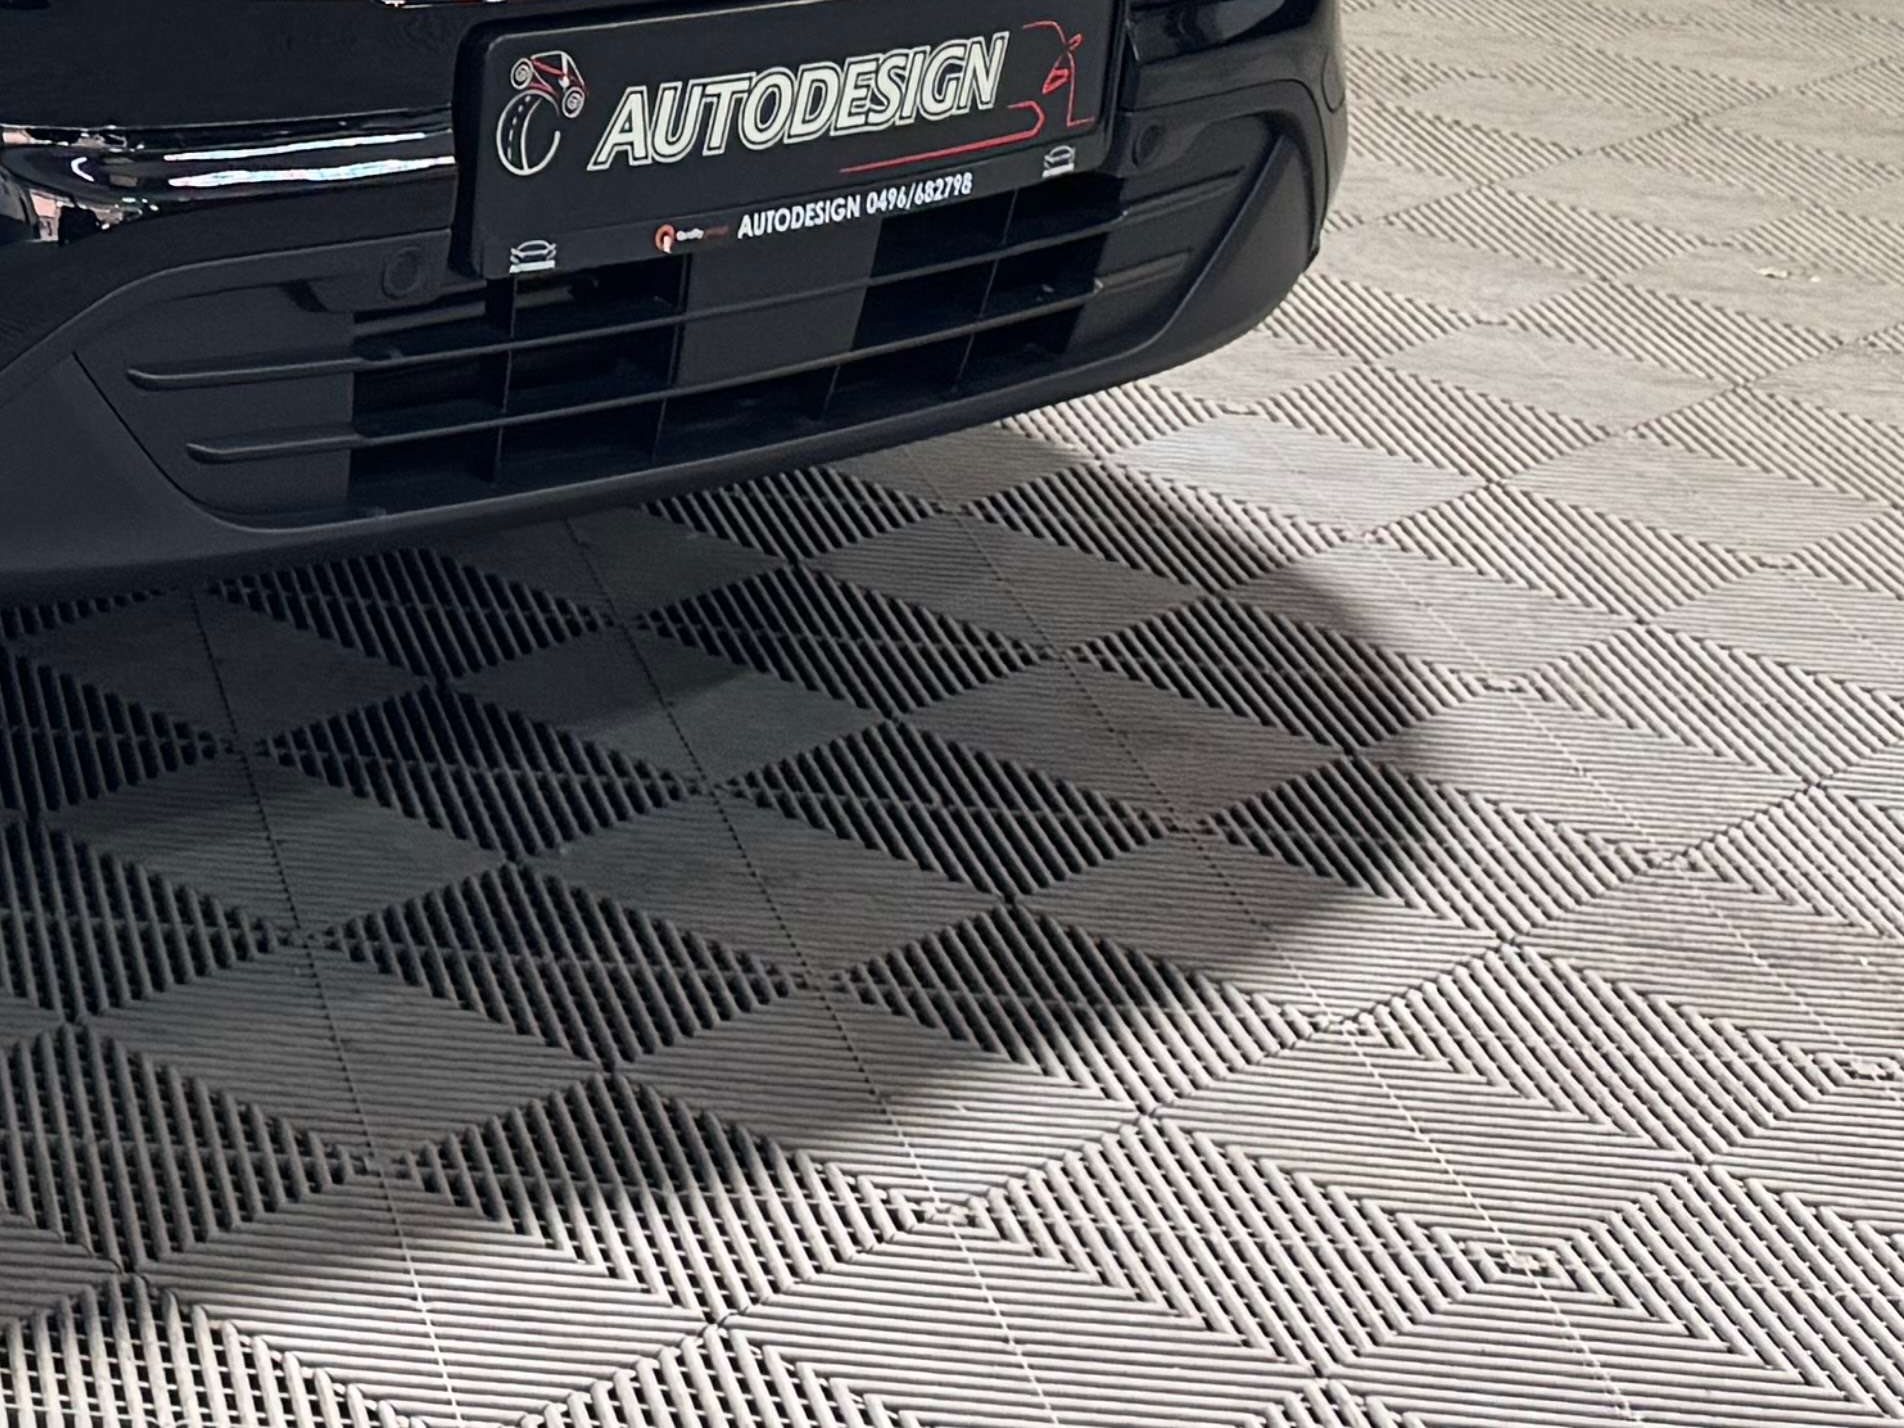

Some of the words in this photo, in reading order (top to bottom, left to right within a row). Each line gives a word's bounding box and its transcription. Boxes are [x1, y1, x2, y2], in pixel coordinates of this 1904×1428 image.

[587, 31, 1010, 171] AUTODESIGN
[737, 196, 861, 240] AUTODESIGN
[865, 172, 974, 217] 0496/682798
